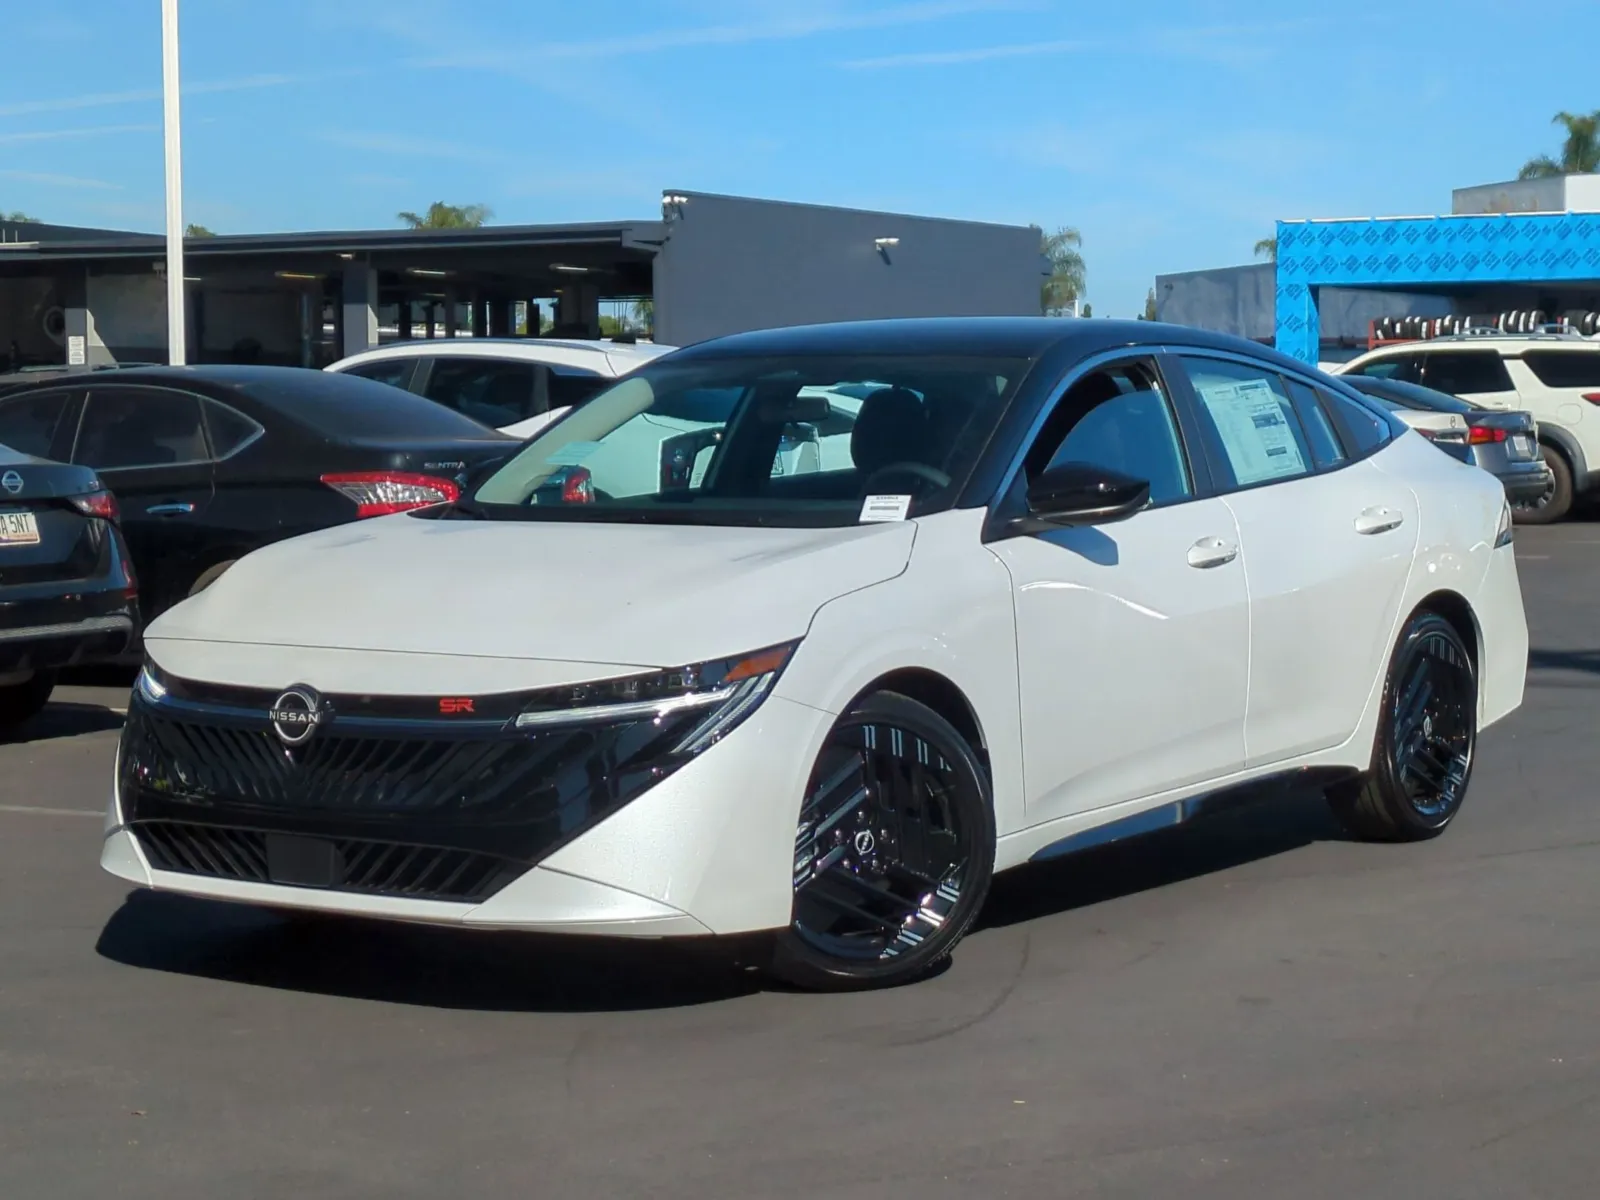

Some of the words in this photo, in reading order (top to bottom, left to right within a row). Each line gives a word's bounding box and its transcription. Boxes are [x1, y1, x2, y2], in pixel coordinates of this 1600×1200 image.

[9, 514, 30, 533] 5NT
[439, 697, 475, 712] SR
[269, 709, 319, 723] NISSAN
